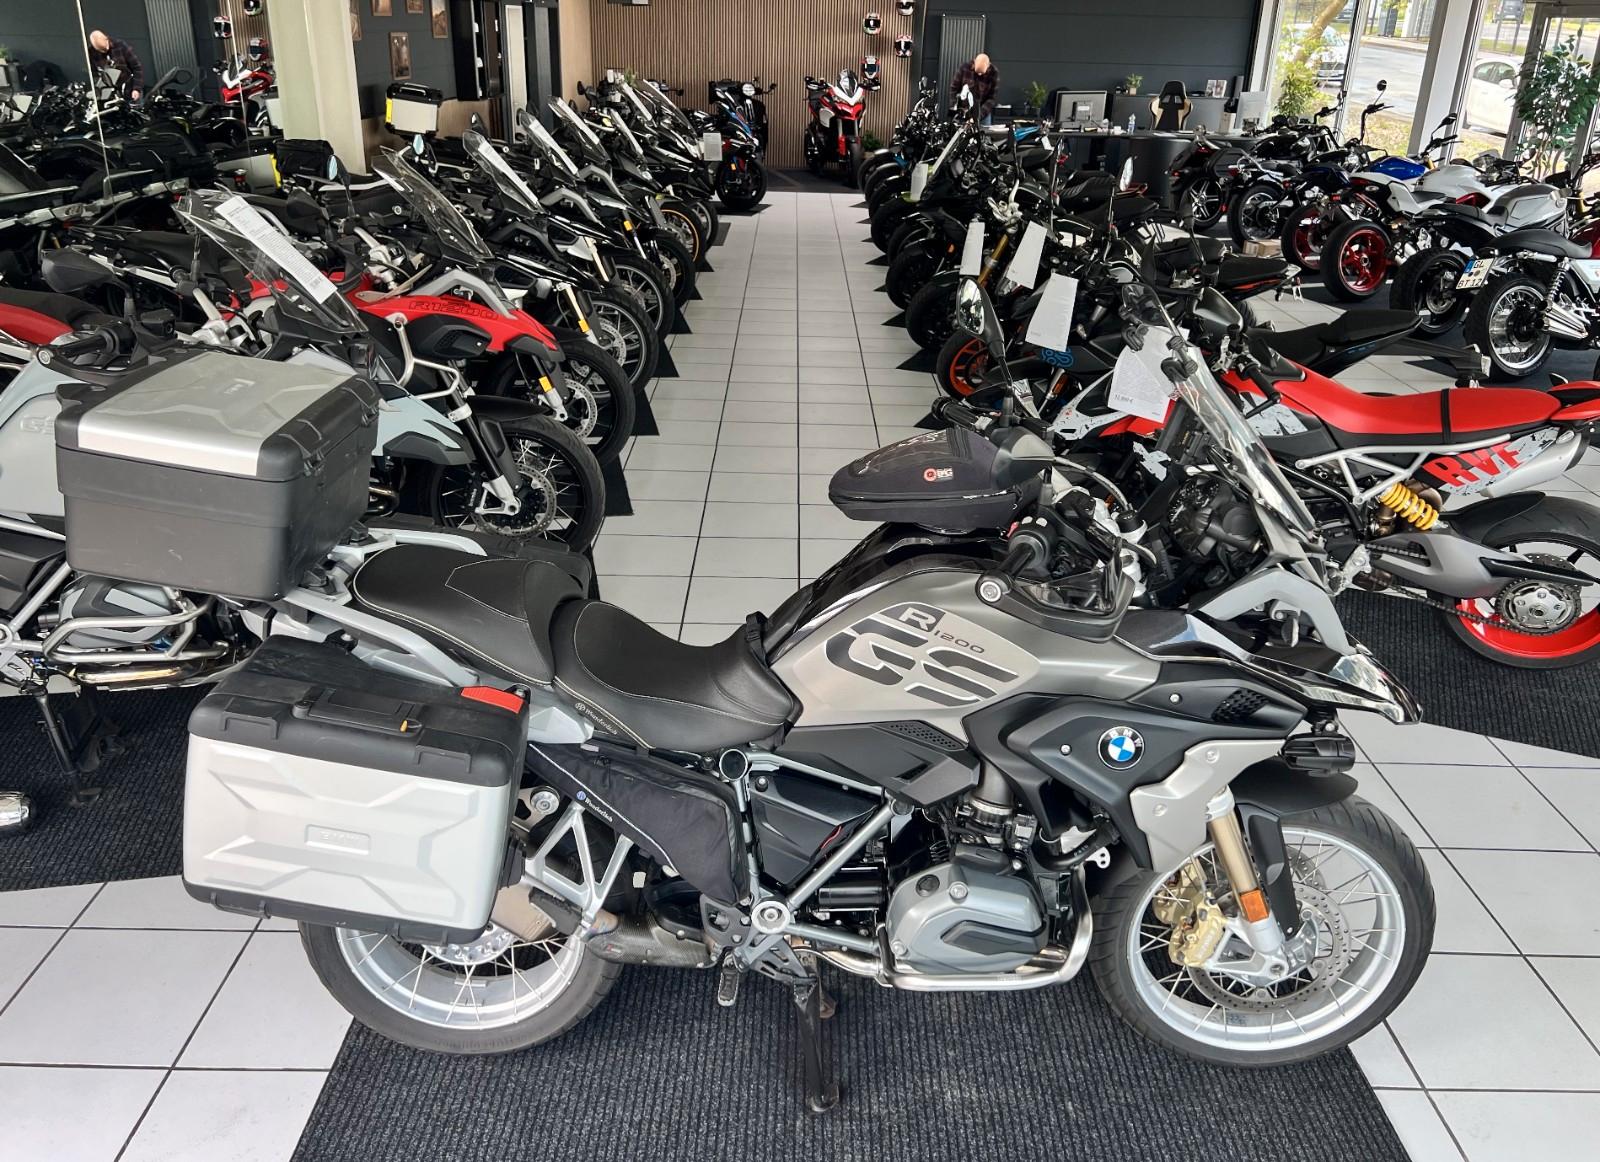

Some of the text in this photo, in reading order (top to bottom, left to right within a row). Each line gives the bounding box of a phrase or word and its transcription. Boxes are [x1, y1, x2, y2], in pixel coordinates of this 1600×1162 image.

[899, 607, 985, 654] R 1200
[825, 617, 1019, 707] GS
[585, 709, 618, 735] Wunderlich
[1107, 728, 1143, 748] BMW
